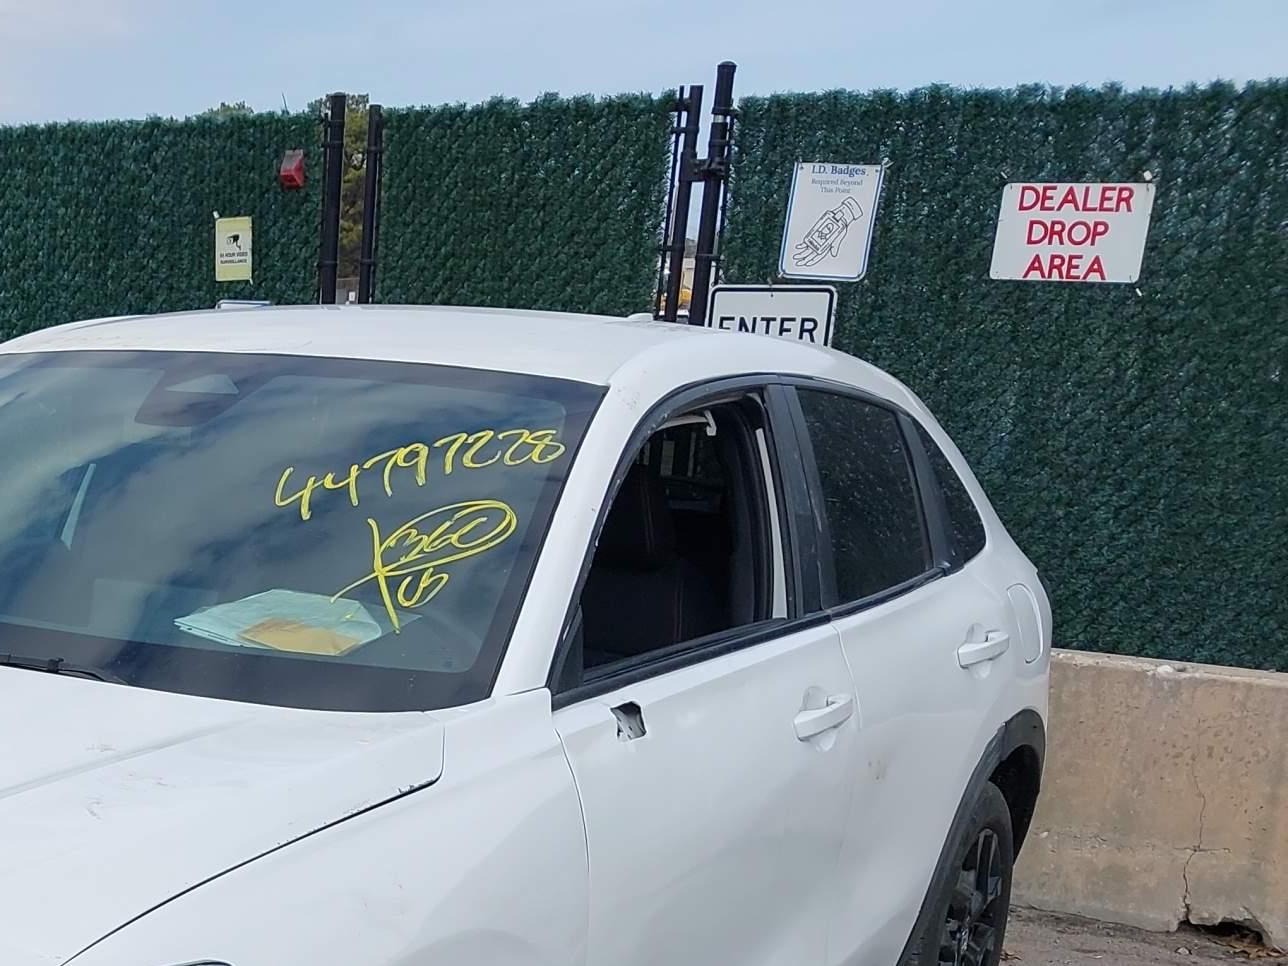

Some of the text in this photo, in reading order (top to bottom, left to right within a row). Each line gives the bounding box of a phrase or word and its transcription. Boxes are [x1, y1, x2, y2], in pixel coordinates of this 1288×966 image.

[1018, 186, 1134, 212] DEALER
[1026, 220, 1109, 246] DROP
[1022, 254, 1106, 280] AREA
[274, 429, 566, 521] 44797228
